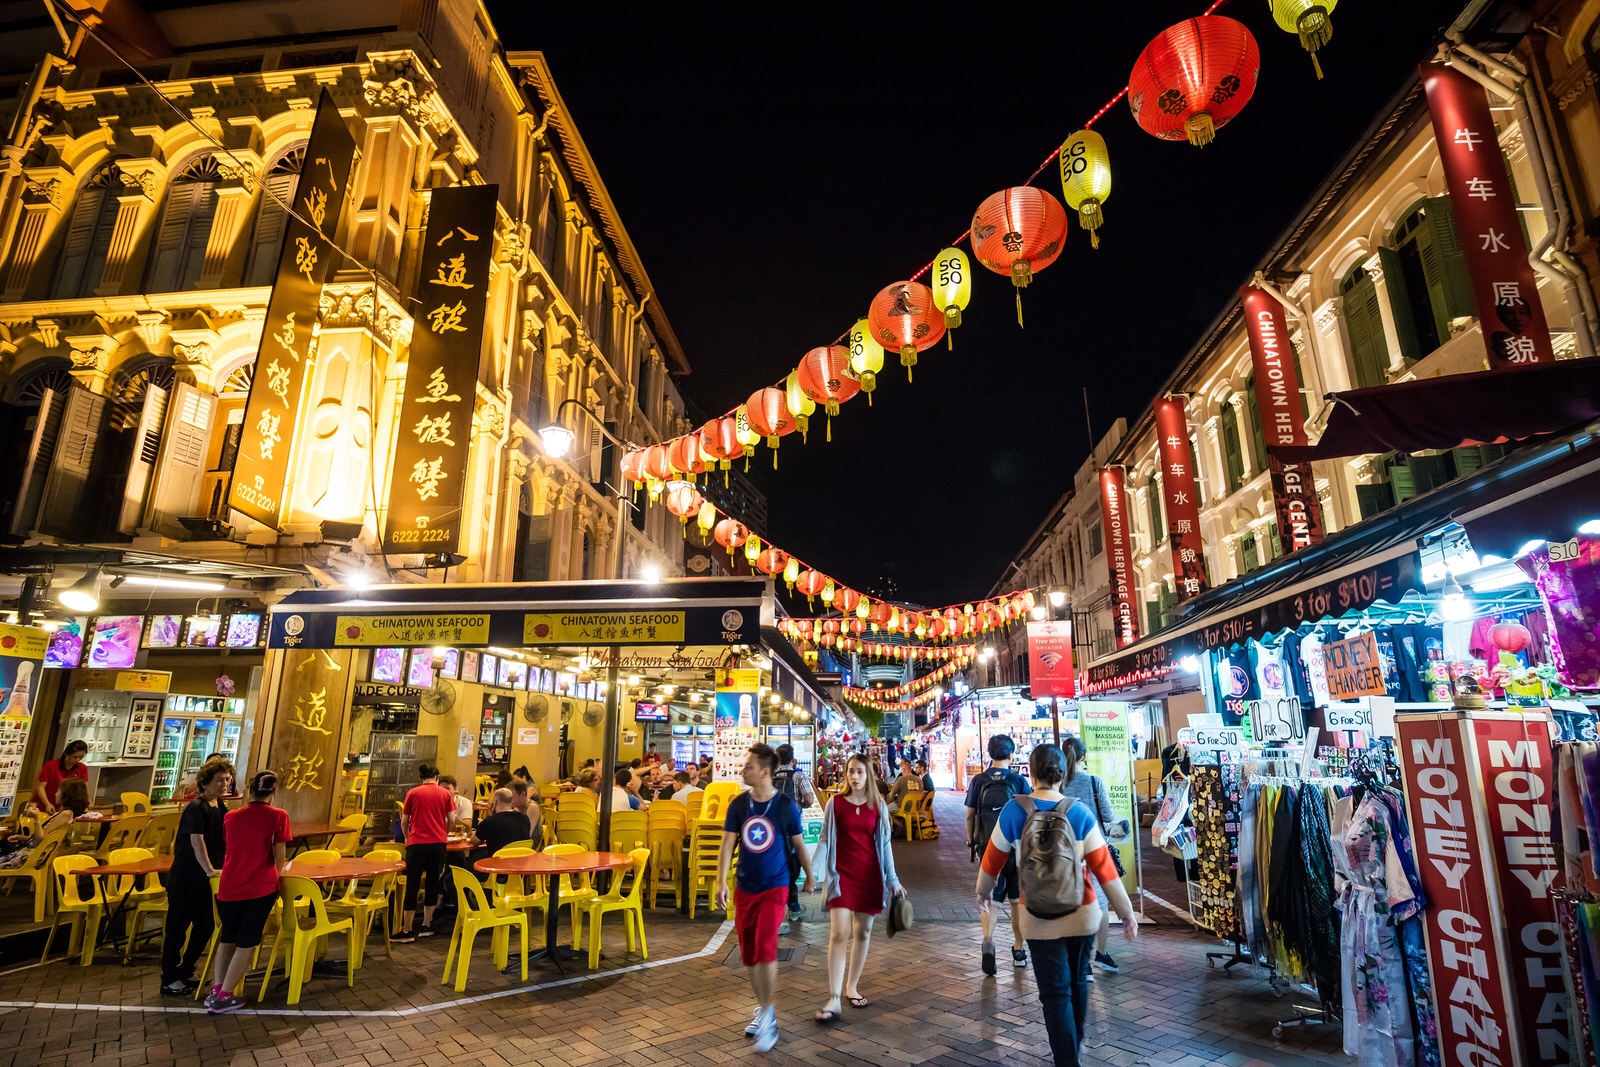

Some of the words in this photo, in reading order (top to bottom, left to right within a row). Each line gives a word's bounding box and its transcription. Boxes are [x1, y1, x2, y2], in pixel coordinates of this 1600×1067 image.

[1061, 141, 1086, 166] SG
[1063, 157, 1088, 182] 50
[939, 257, 962, 272] SG
[939, 271, 963, 286] 50
[1257, 311, 1288, 406] CHINATOWN
[236, 482, 257, 504] 6222
[256, 493, 276, 514] 2224
[1107, 484, 1123, 545] CHINATOWN
[1166, 435, 1200, 593] 牛车水原貌馆
[392, 530, 420, 543] 6222
[422, 529, 451, 542] 2224
[1114, 548, 1129, 599] HERITAGE
[1294, 598, 1304, 620] 3
[1308, 592, 1332, 616] for
[372, 618, 434, 628] CHINATOWN
[437, 617, 484, 627] SEAFOOD
[561, 615, 627, 626] CHINATOWN
[629, 614, 679, 625] SEAFOOD
[1119, 602, 1133, 644] CENTRE
[284, 636, 303, 646] Tiger
[721, 631, 743, 642] Tiger
[1197, 633, 1204, 650] 3
[1205, 630, 1219, 646] for
[590, 647, 662, 667] Chinatown
[667, 647, 731, 671] Seafood
[1136, 654, 1141, 669] 3
[1141, 653, 1151, 667] for
[1323, 636, 1372, 672] MONEY
[1328, 666, 1383, 695] CHANGER
[1248, 701, 1264, 742] 10
[1264, 723, 1278, 738] FOR
[1328, 711, 1339, 725] 6
[1340, 716, 1354, 725] FOR
[1196, 731, 1206, 745] 6
[1207, 736, 1219, 745] FOR
[1411, 737, 1472, 890] MONEY
[1487, 739, 1559, 899] MONEY
